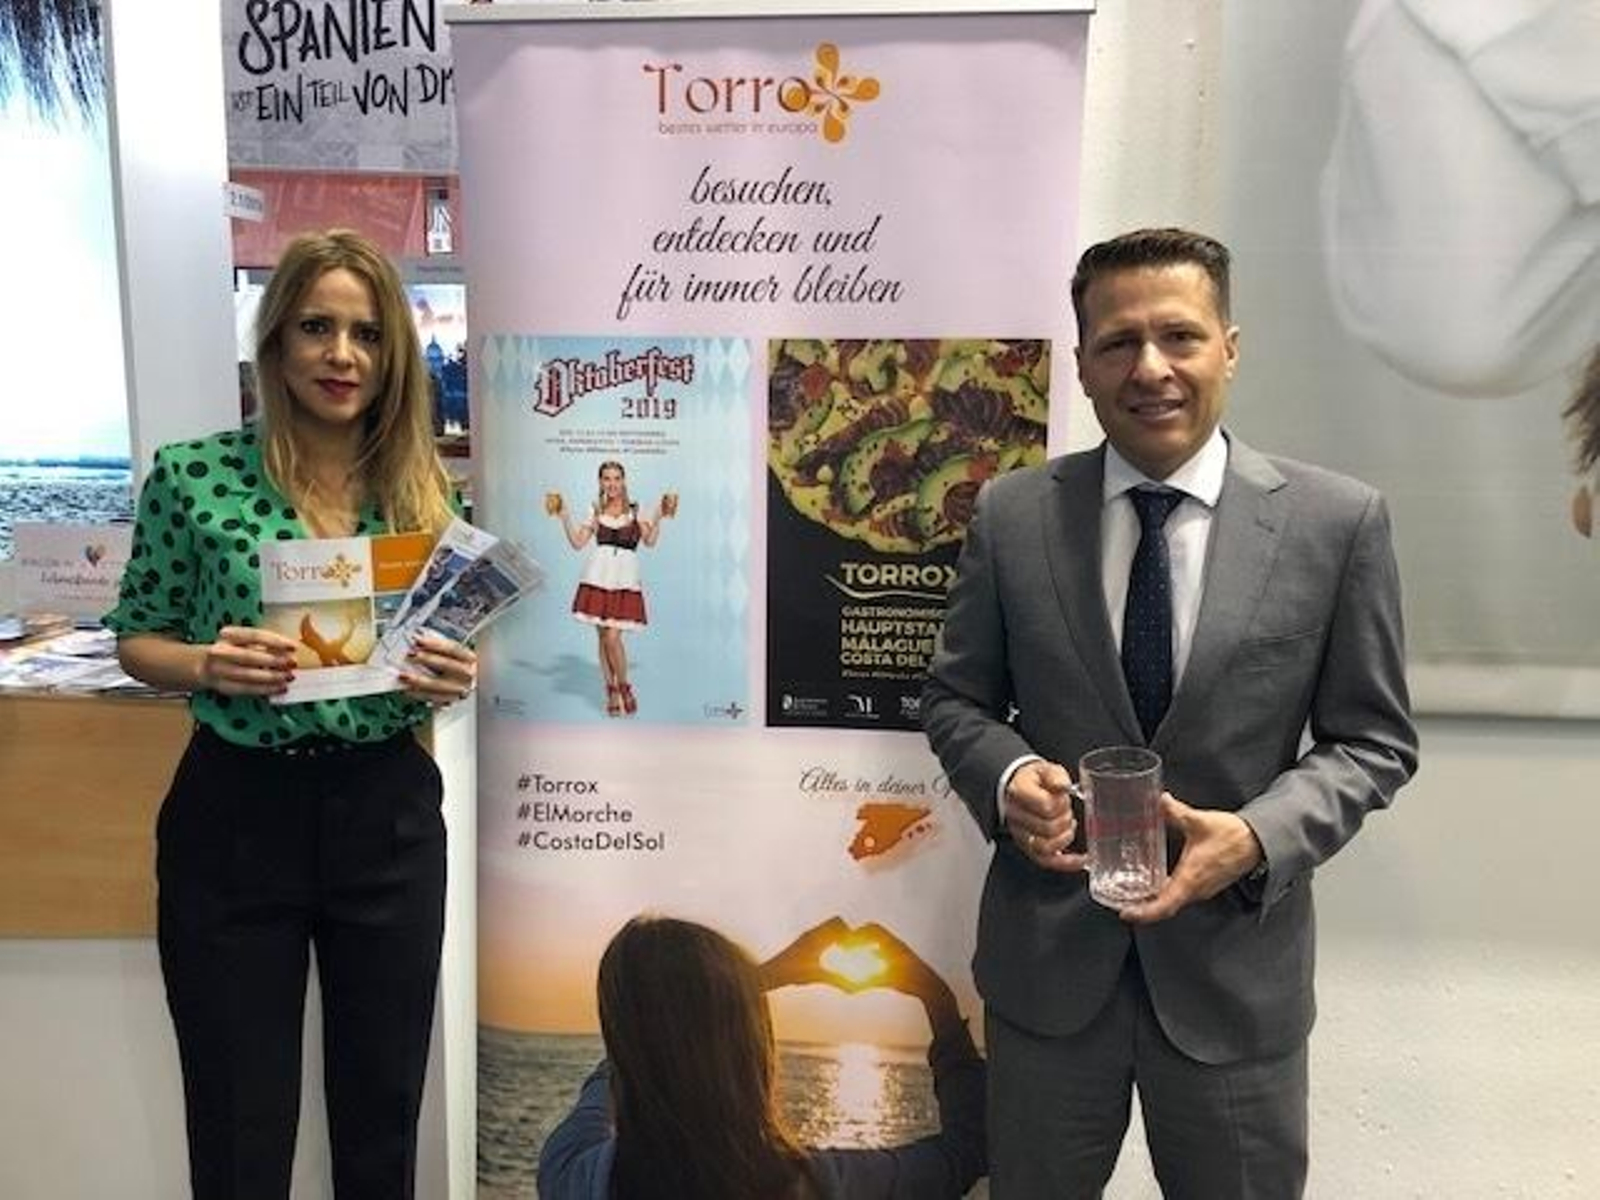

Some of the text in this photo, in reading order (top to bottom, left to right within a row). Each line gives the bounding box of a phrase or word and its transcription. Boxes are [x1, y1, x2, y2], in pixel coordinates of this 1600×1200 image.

[238, 0, 437, 75] SPANIEN
[255, 74, 303, 123] EIN
[306, 79, 350, 108] TEIL
[352, 69, 408, 116] VON
[690, 165, 832, 207] besuchen,
[652, 215, 882, 253] entdecken und
[616, 263, 905, 320] für immer bleiben
[533, 346, 695, 418] Oktoberfest
[620, 396, 679, 420] 2019
[839, 651, 928, 668] COSTA DEL
[517, 774, 599, 794] #Torrox
[517, 802, 633, 822] #ElMorche
[517, 831, 666, 851] #CostaDelSol
